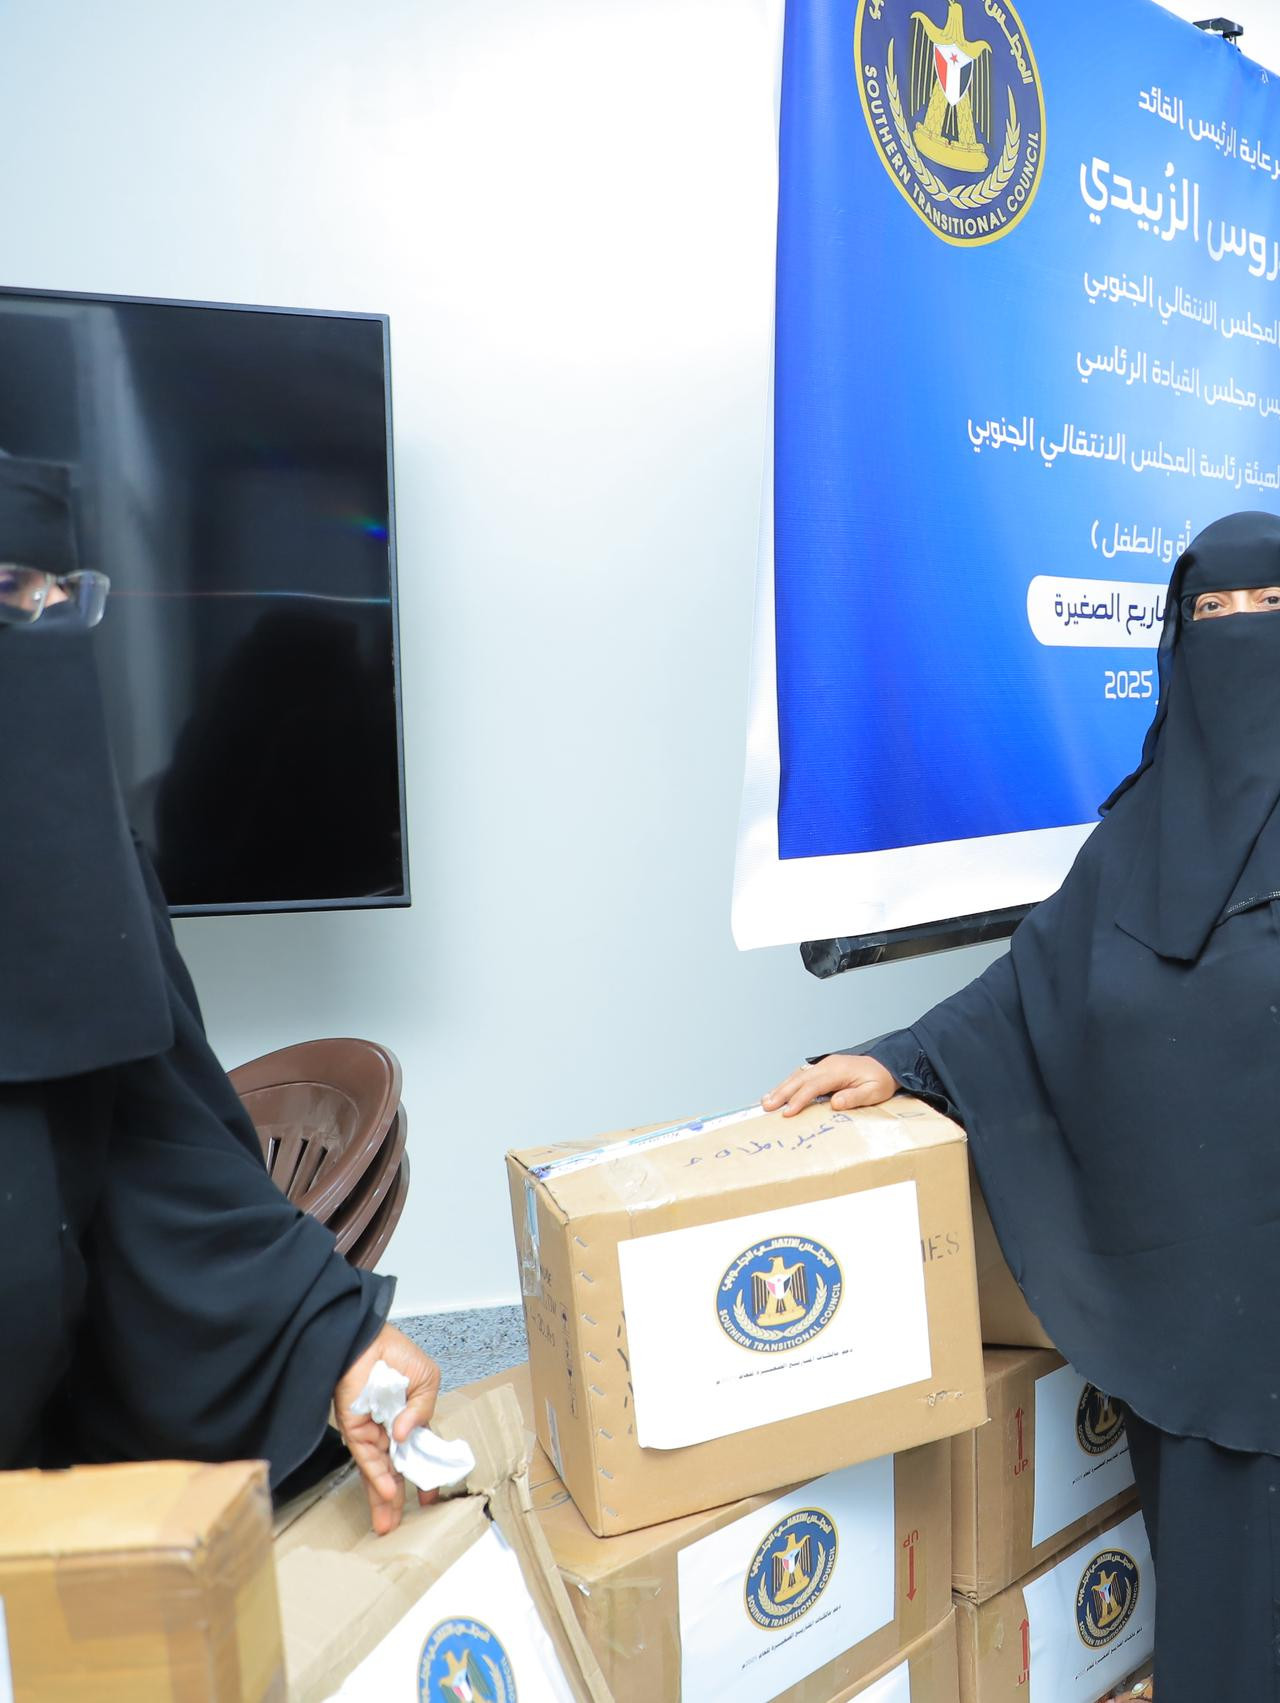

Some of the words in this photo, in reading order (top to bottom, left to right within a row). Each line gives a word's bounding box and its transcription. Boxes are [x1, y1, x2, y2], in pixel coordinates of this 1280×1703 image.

[1138, 86, 1184, 130] القائد
[864, 65, 911, 185] SOUTHERN
[912, 183, 1007, 236] TRANSITIONAL
[1007, 131, 1039, 213] COUNCIL
[1188, 120, 1237, 159] الرئيس
[1084, 271, 1153, 308] الجنوبي
[1158, 285, 1217, 331] الانتقالي
[1076, 345, 1147, 385] الرئاسي
[1151, 360, 1200, 398] القيادة
[1203, 377, 1256, 411] مجلس
[967, 416, 1034, 453] الجنوبي
[1040, 423, 1127, 468] الانتقالي
[1131, 441, 1196, 477] المجلس
[1199, 453, 1243, 489] رئاسة
[1244, 461, 1280, 492] لهيئة
[1054, 593, 1120, 627] الصغيرة
[1104, 670, 1153, 699] 2025
[719, 1309, 752, 1347] SOUTHERN
[752, 1325, 821, 1352] TRANSITIONAL
[820, 1282, 840, 1325] COUNCIL
[1014, 1458, 1029, 1476] UP
[902, 1529, 919, 1548] UP
[747, 1595, 769, 1627] SOUTHERN
[770, 1591, 820, 1627] TRANSITIONAL
[819, 1545, 836, 1589] COUNCIL
